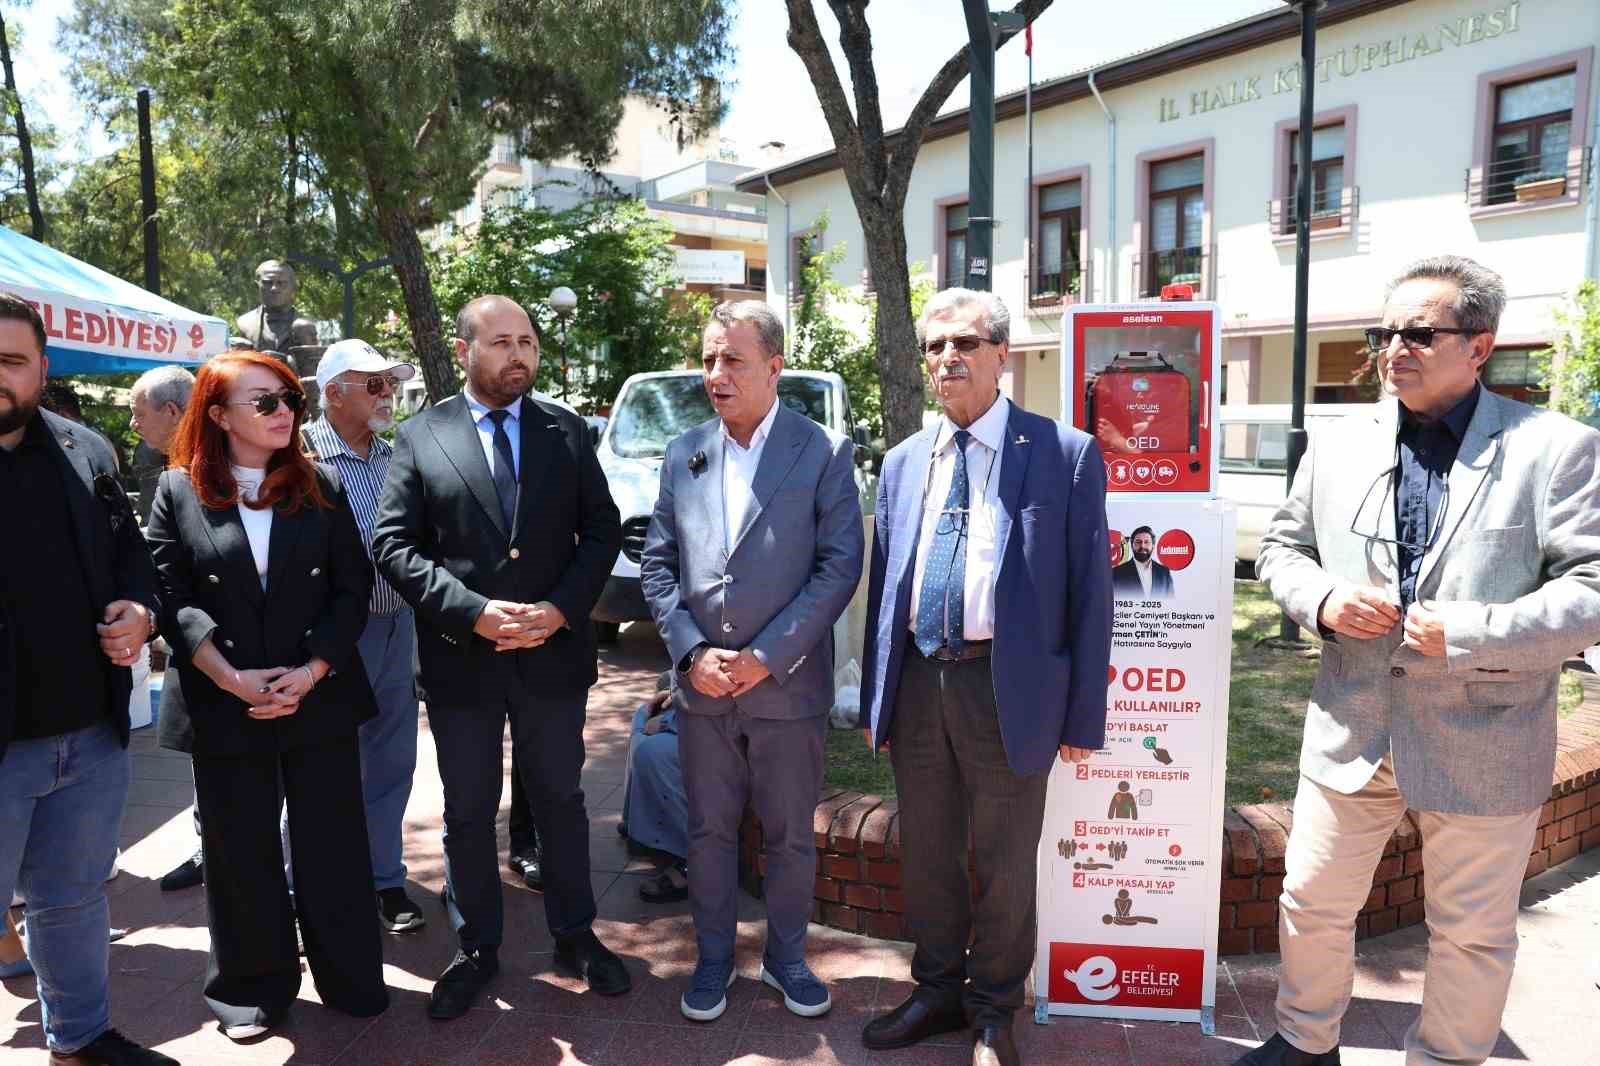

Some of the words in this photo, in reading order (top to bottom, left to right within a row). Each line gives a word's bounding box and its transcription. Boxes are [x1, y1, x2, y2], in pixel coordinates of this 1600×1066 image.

[1189, 75, 1262, 115] HALK
[1122, 314, 1162, 323] aselsan
[24, 301, 177, 354] LEDİYESİ
[1126, 437, 1160, 449] OED
[1115, 600, 1134, 608] 1983
[1141, 601, 1162, 609] 2025
[1133, 612, 1170, 621] Cemiyeti
[1171, 612, 1203, 622] Başkanı
[1113, 621, 1137, 629] Genel
[1139, 622, 1161, 631] Yayın
[1162, 621, 1206, 631] Yönetmeni
[1134, 630, 1168, 640] ÇETİN'in
[1113, 641, 1156, 649] Hatırasına
[1156, 641, 1193, 651] Saygıyla
[1122, 668, 1186, 692] OED
[1114, 700, 1201, 713] KULLANILIR?
[1104, 721, 1127, 732] D'Yİ
[1129, 722, 1169, 733] BAŞLAT
[1091, 767, 1133, 779] PEDLERİ
[1136, 770, 1191, 782] YERLEŞTİR
[1076, 823, 1085, 835] 3
[1090, 823, 1125, 836] OED'Yİ
[1127, 826, 1156, 837] TAKİP
[1157, 828, 1170, 838] ET
[1088, 877, 1114, 887] KALP
[1116, 879, 1153, 889] MASAJI
[1155, 881, 1176, 890] YAP
[1122, 970, 1180, 986] EFELER
[1127, 986, 1173, 996] BELEDİYESİ
